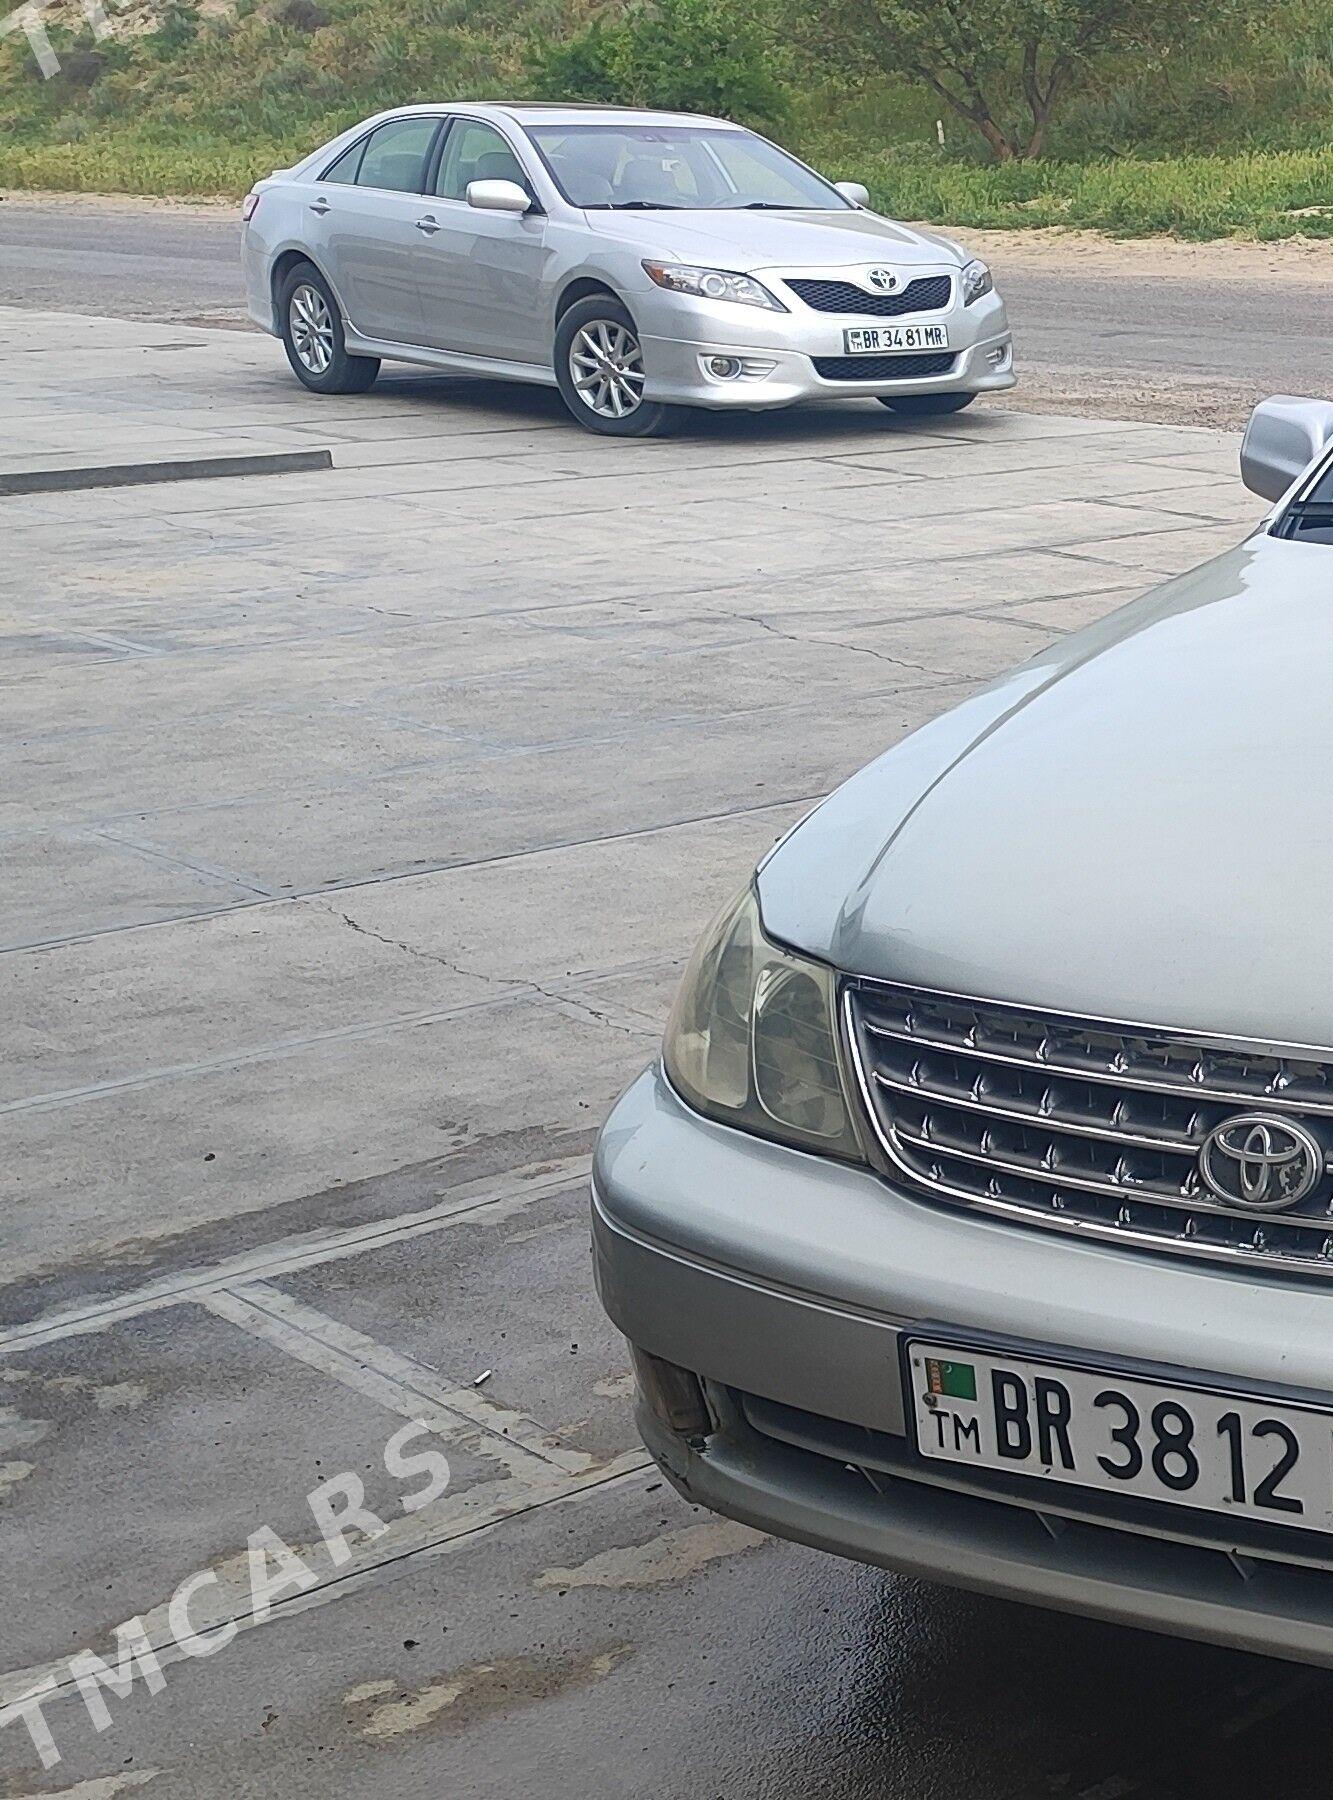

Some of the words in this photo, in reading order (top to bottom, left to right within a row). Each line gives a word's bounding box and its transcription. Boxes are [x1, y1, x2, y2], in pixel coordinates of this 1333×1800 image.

[862, 330, 880, 348] BR
[924, 327, 943, 345] MR
[929, 1409, 981, 1454] TM
[990, 1368, 1075, 1470] BR
